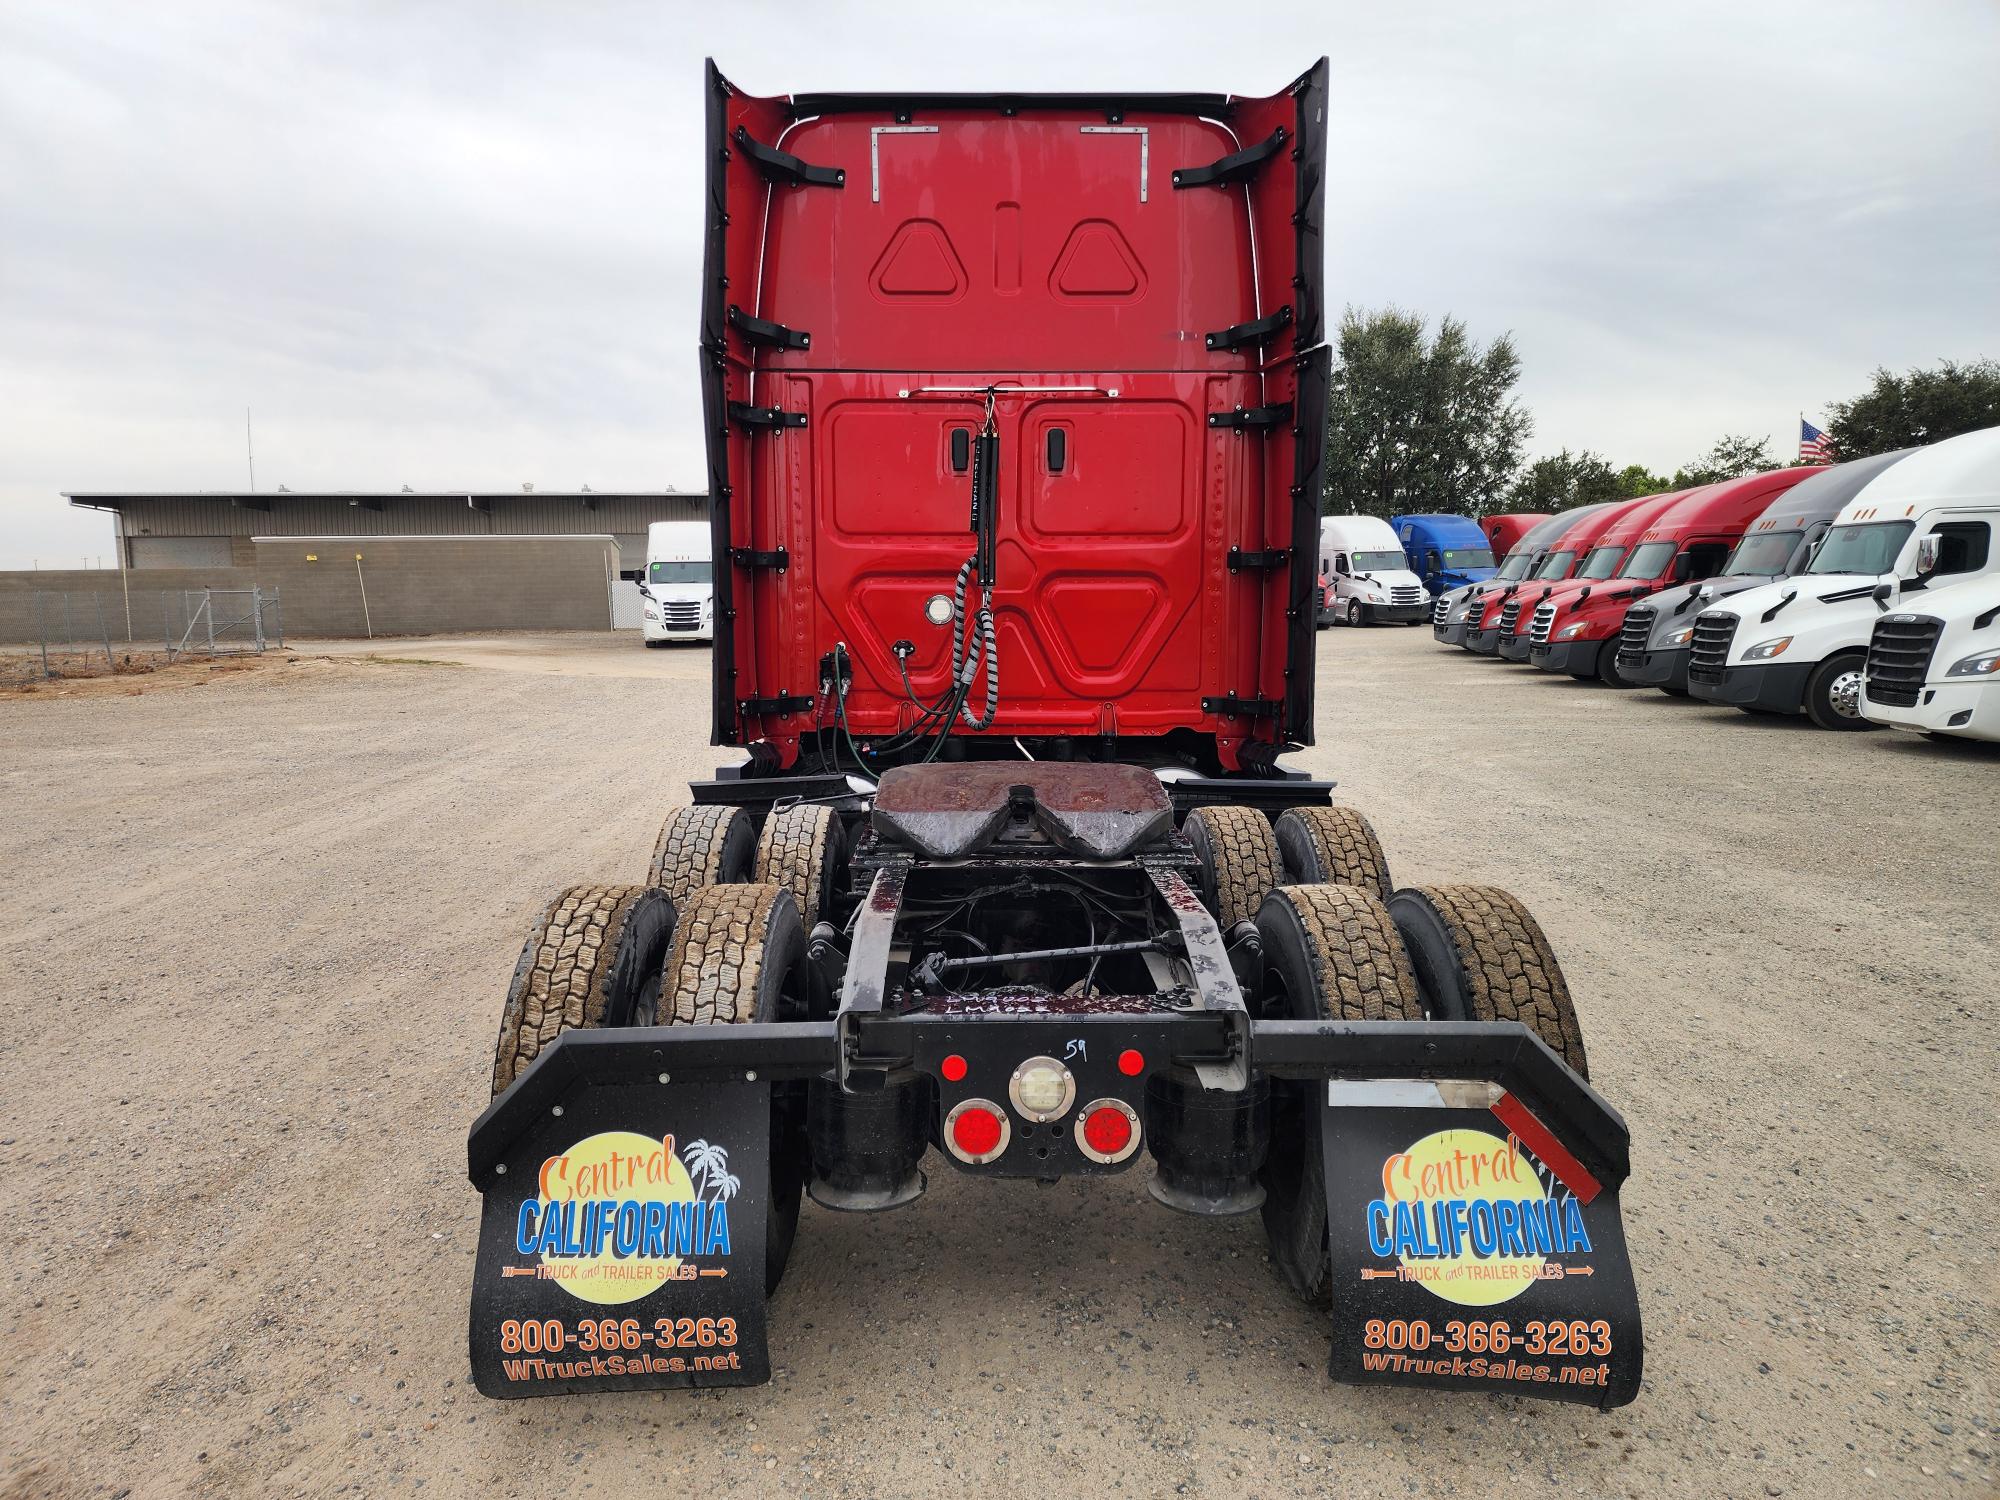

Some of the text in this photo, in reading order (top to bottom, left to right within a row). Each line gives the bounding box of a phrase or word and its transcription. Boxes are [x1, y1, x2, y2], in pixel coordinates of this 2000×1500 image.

[1063, 1039, 1088, 1062] 59
[538, 1134, 676, 1205] Central
[1382, 1132, 1521, 1205] Central
[516, 1198, 732, 1256] CALIFORNIA
[1367, 1197, 1592, 1257] CALIFORNIA
[536, 1263, 698, 1281] TRUCK and TRAILER SALES
[1396, 1263, 1565, 1282] TRUCK and TRAILER SALES
[500, 1317, 738, 1354] 800-366-3263
[1363, 1319, 1612, 1356] 800-366-3263
[502, 1351, 741, 1382] WTruckSales.net
[1362, 1353, 1610, 1386] WTruckSales.net
